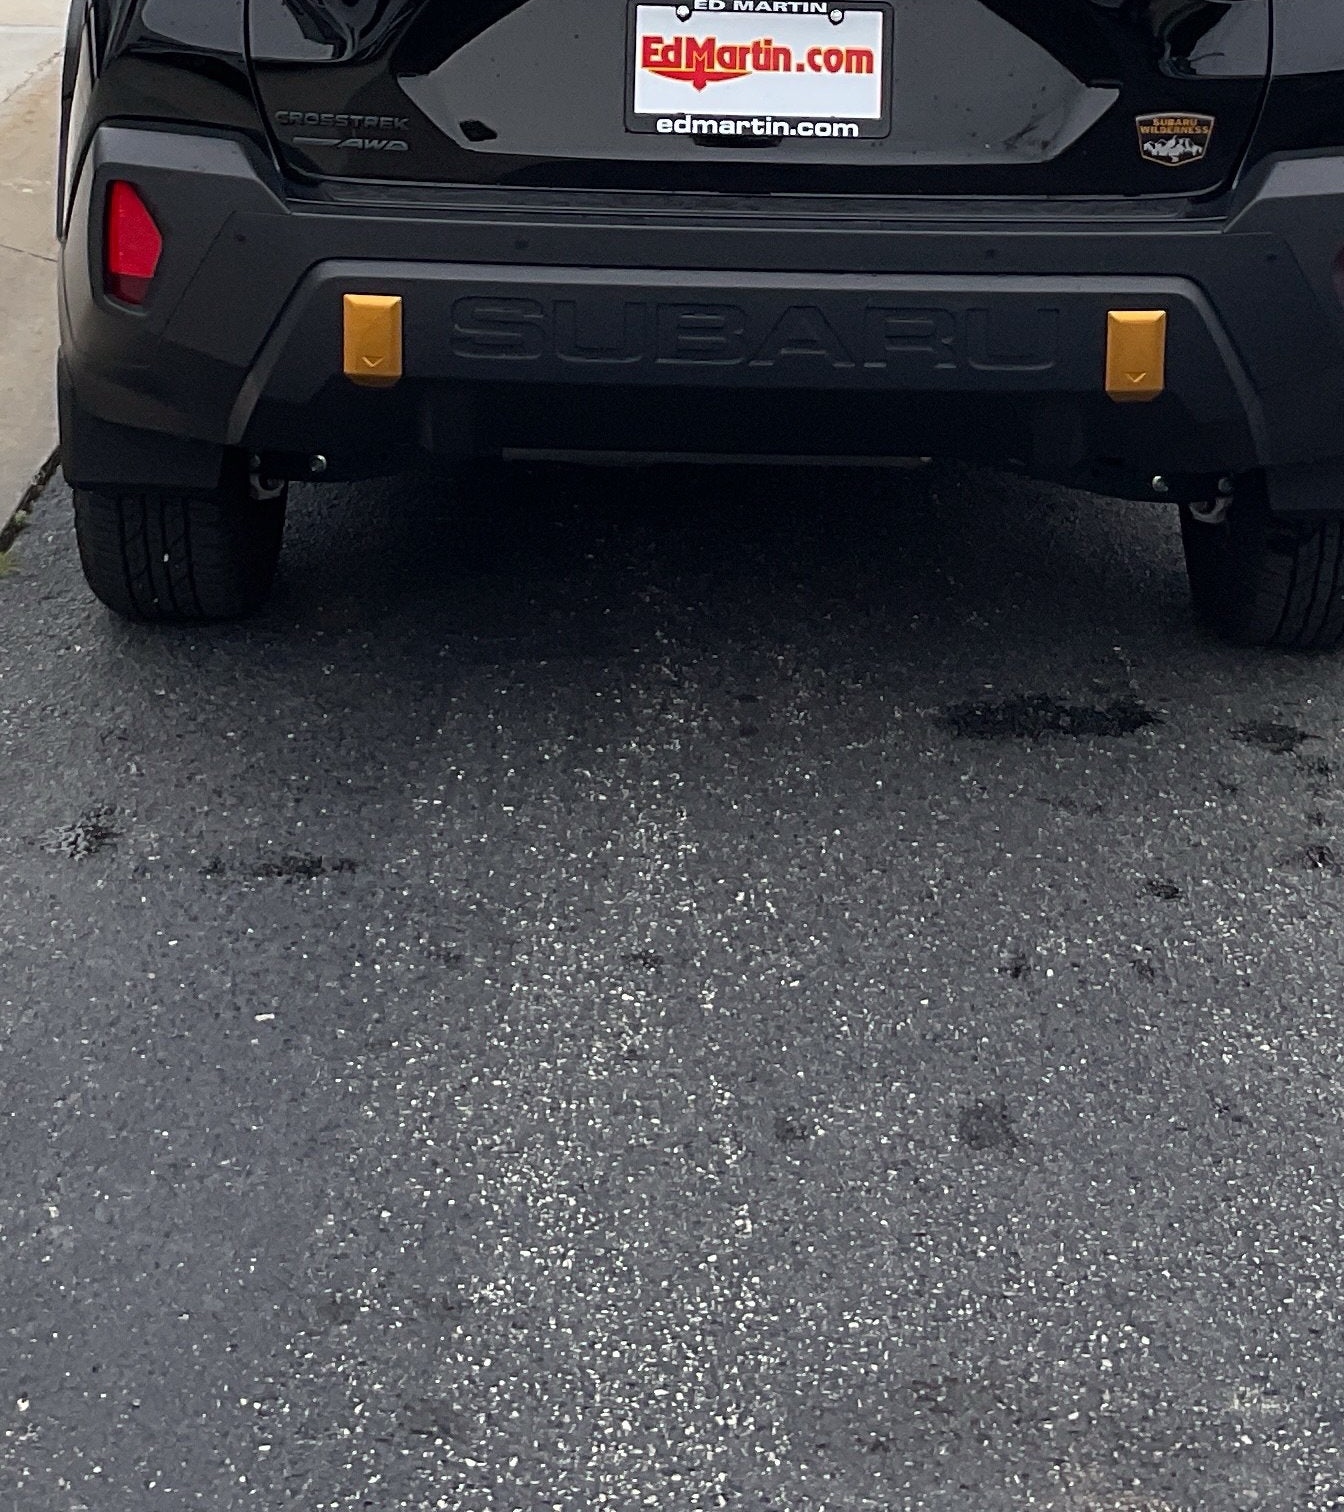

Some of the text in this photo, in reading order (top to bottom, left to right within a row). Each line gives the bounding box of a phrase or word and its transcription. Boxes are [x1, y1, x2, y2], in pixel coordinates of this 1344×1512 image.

[694, 0, 827, 13] ED MARTIN
[641, 34, 874, 76] EdMartin.com
[273, 110, 411, 132] CROSSTREK
[656, 116, 859, 138] edmartin.com
[1140, 125, 1210, 134] WILDERNESS
[1152, 118, 1198, 126] SUBARU
[337, 137, 409, 152] AWD
[452, 294, 1061, 373] SUBARU
